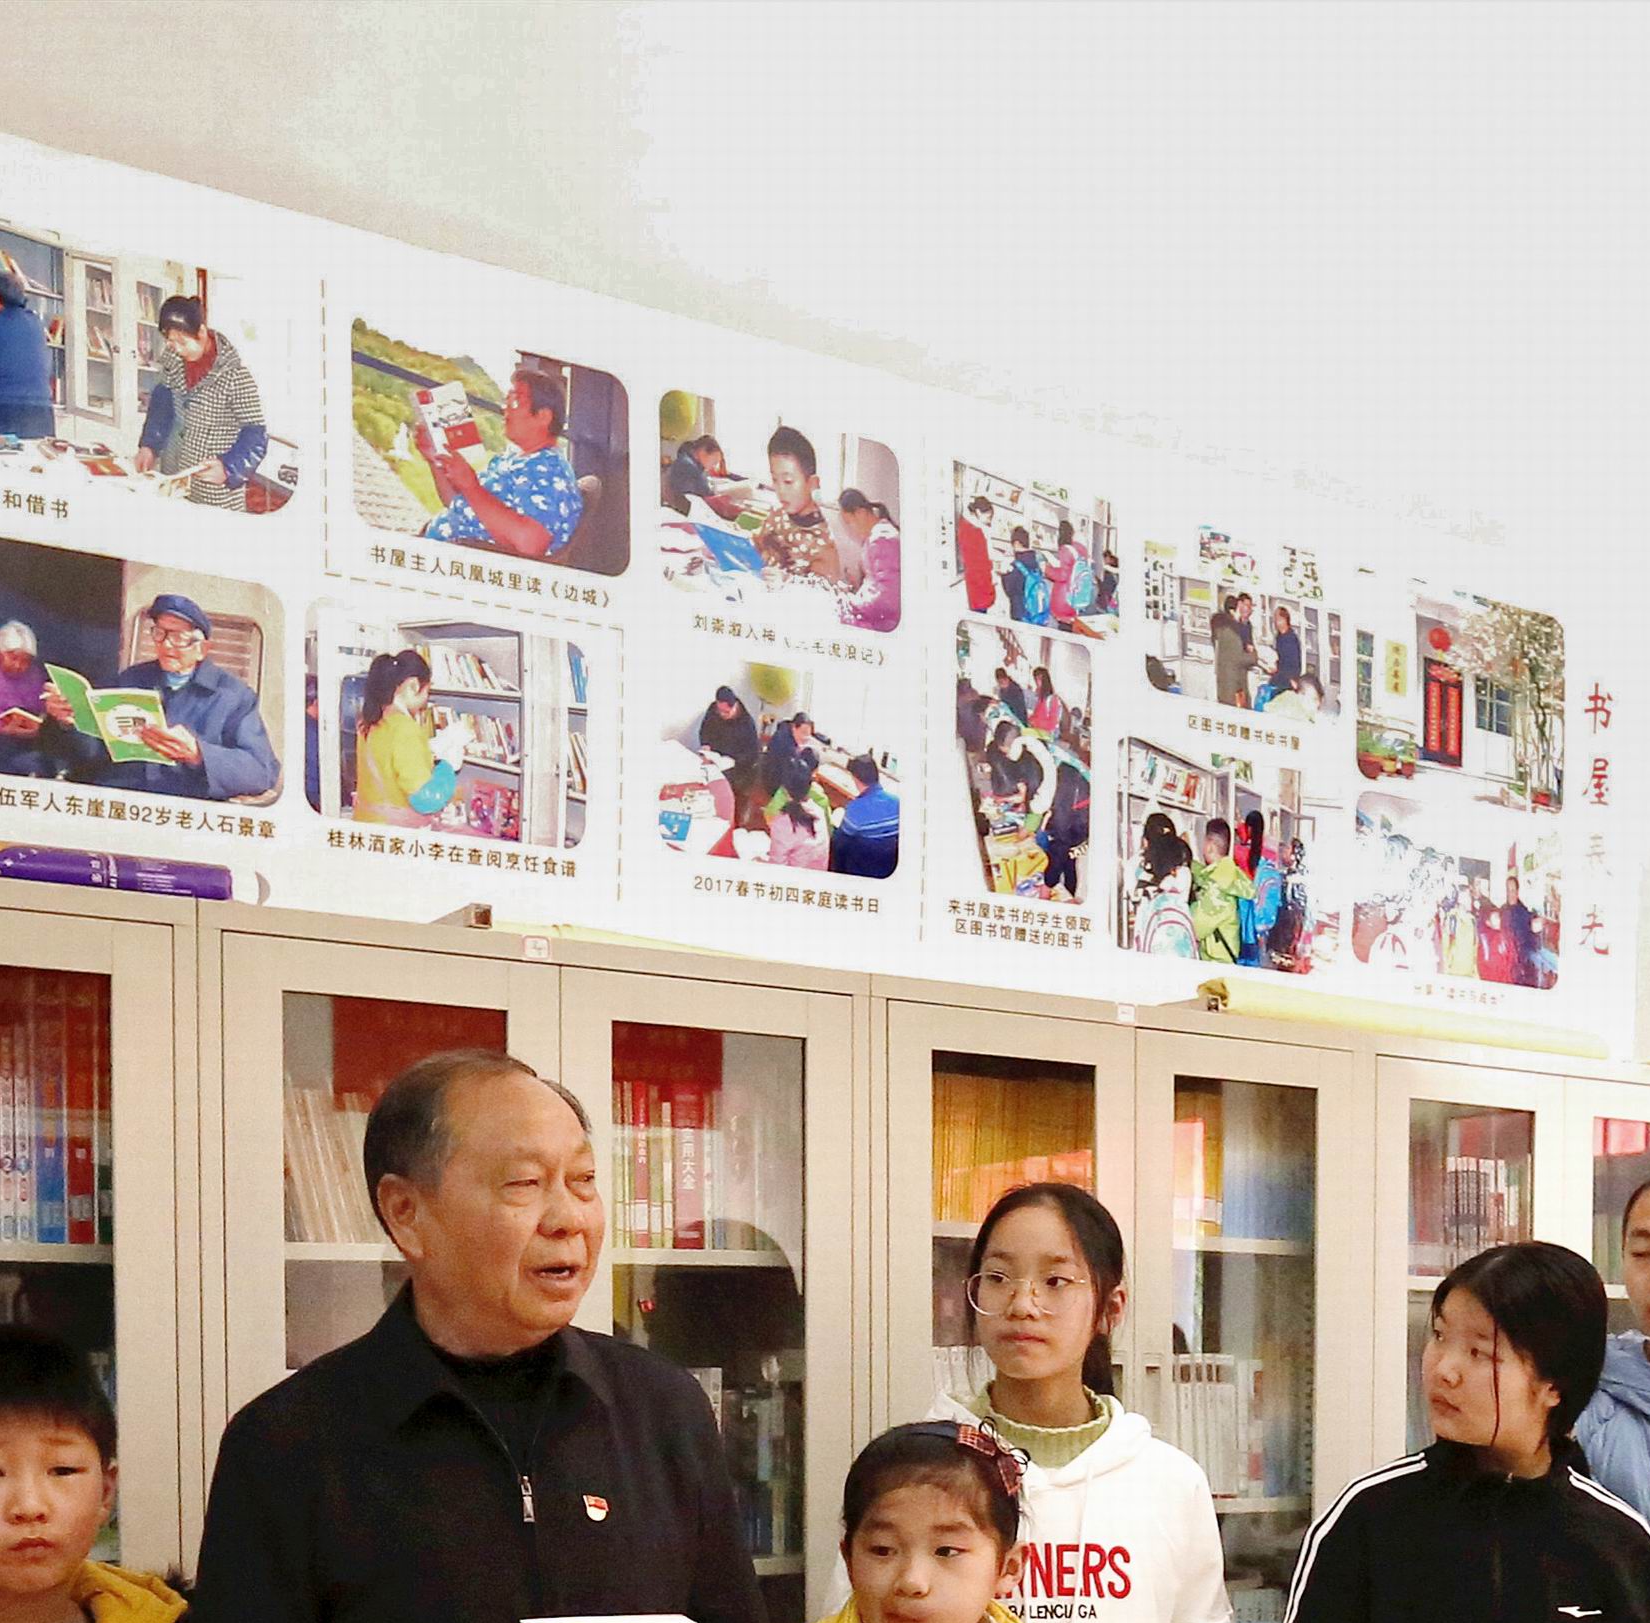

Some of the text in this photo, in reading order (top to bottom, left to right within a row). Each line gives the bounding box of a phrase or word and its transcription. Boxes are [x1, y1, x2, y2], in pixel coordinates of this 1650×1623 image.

[326, 829, 577, 878] 桂林酒家小李在查阅烹饪食谱
[694, 875, 880, 914] 2017春节初四家庭读书日
[994, 1542, 1131, 1600] NERS
